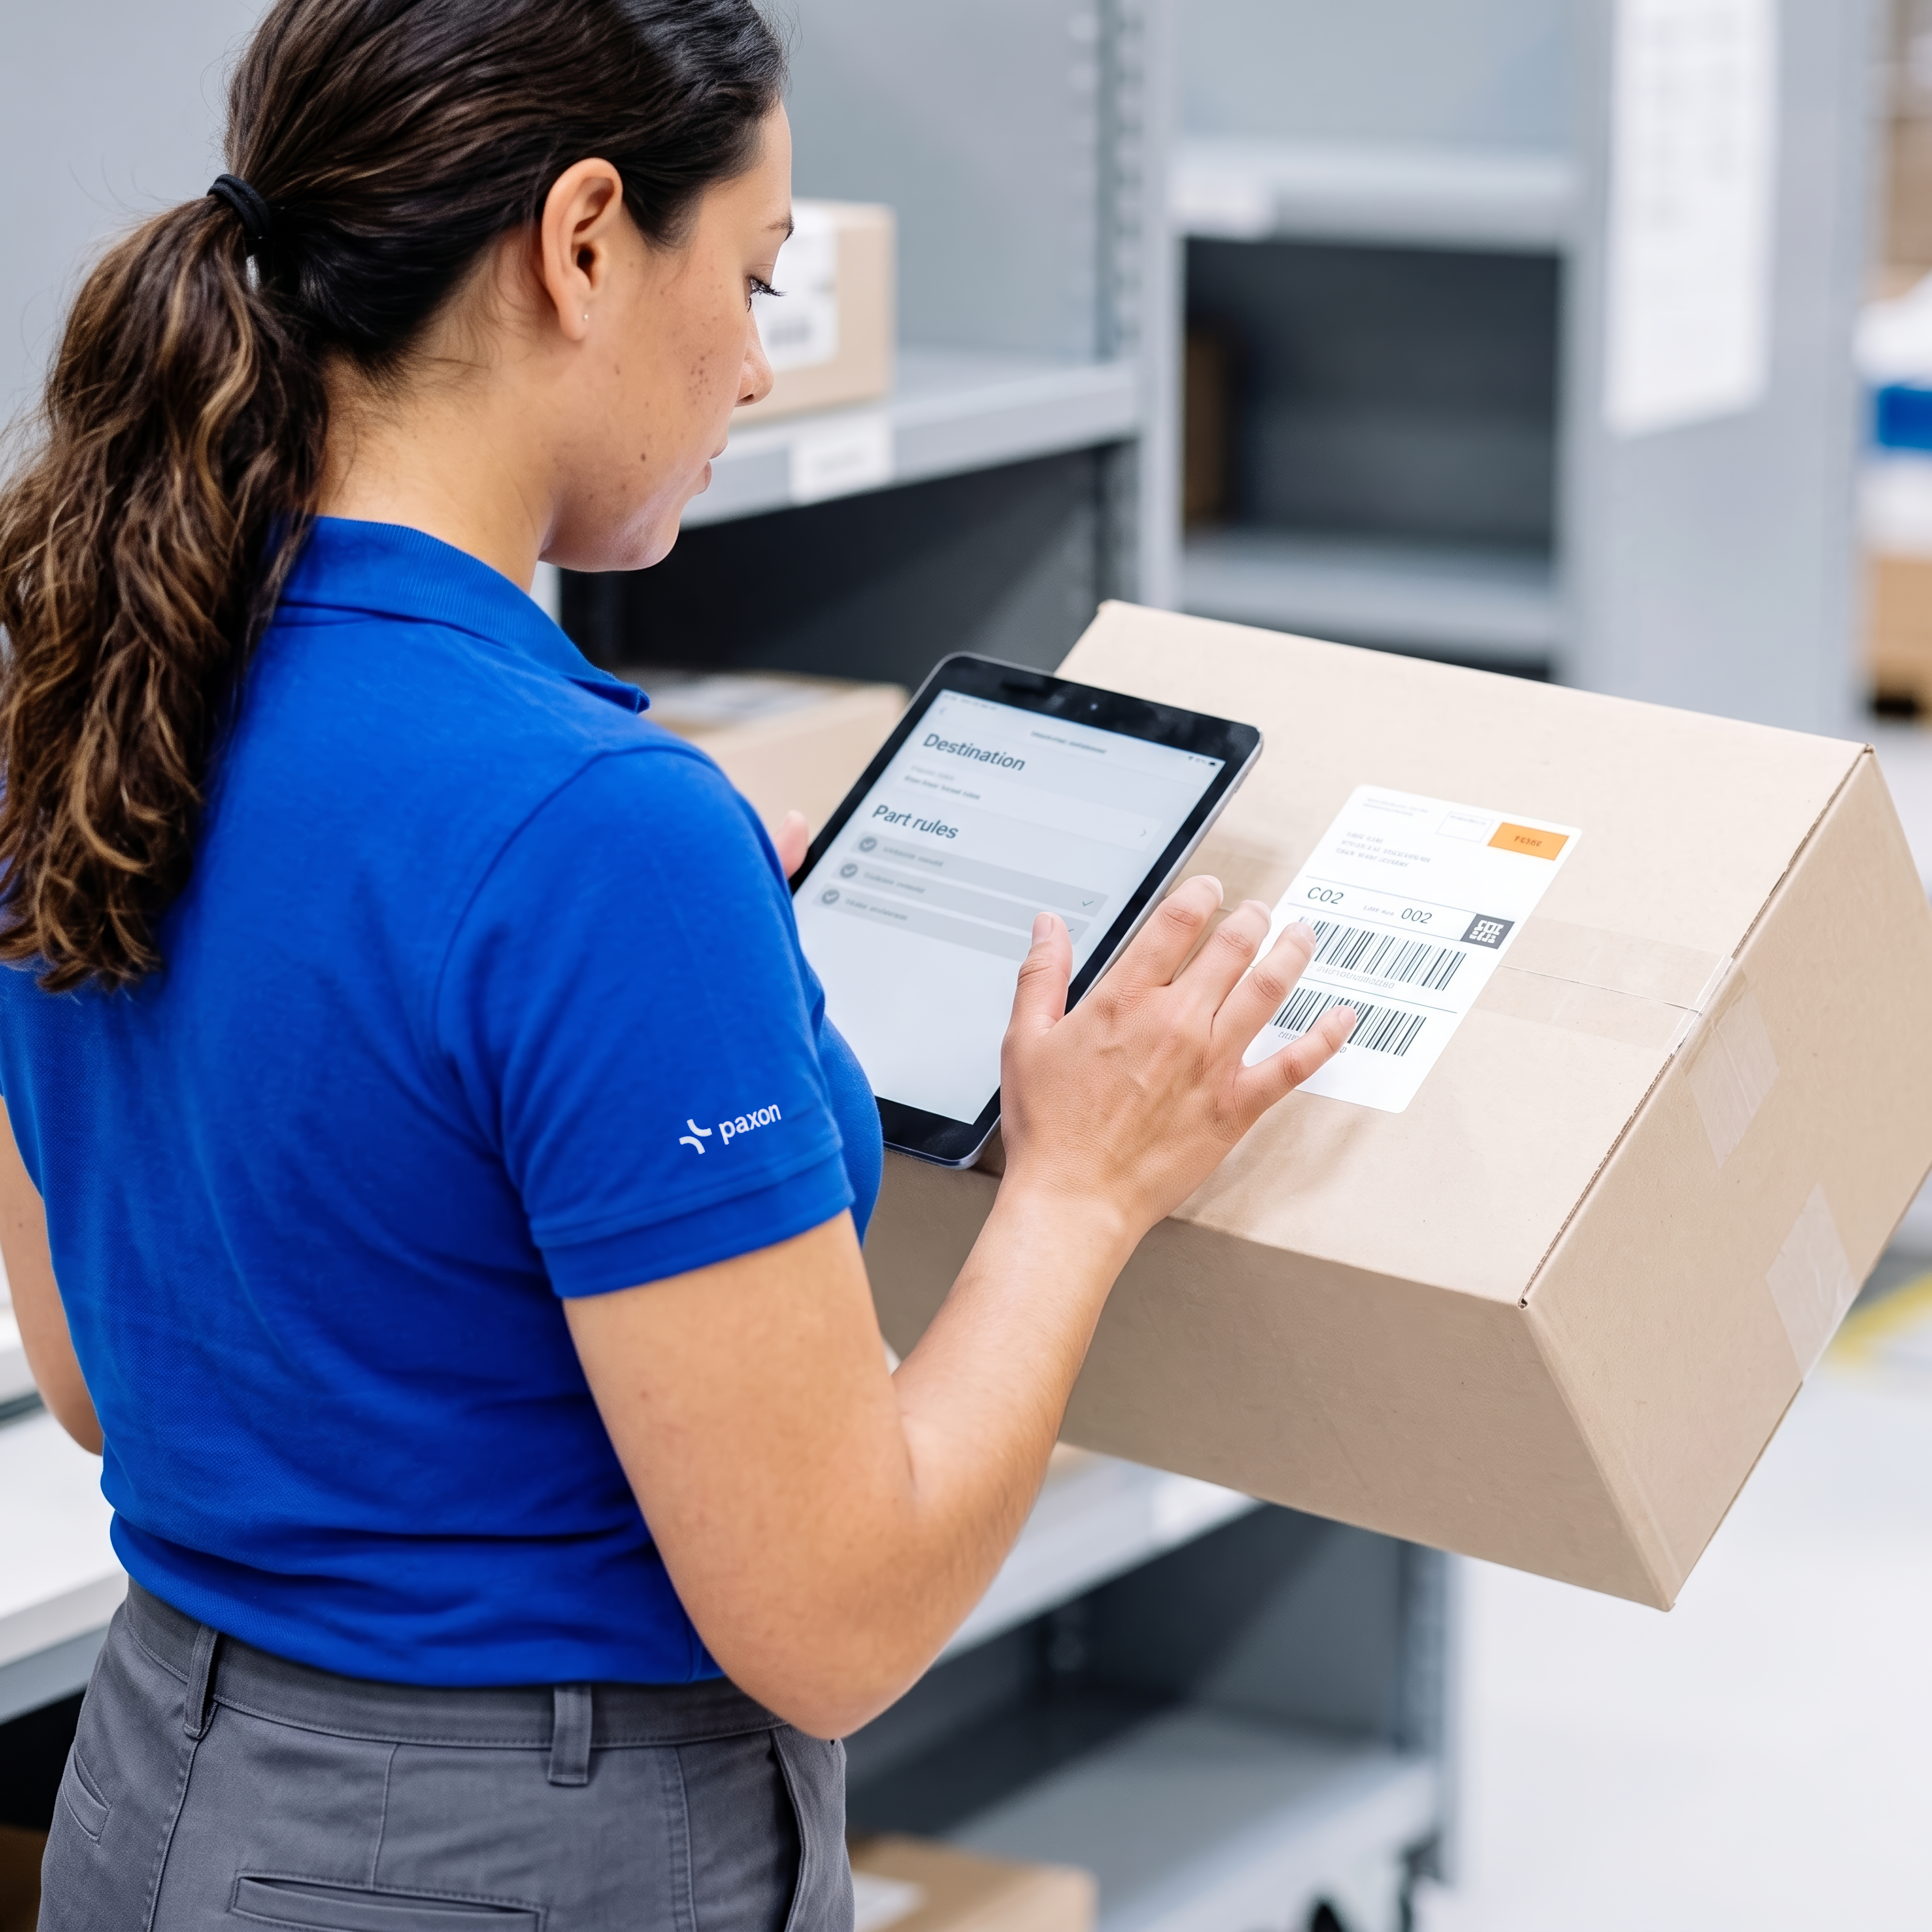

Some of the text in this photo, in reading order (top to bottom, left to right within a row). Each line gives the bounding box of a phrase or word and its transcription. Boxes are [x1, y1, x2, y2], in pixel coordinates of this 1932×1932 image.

[923, 733, 1026, 771] Destination
[872, 804, 959, 839] Part rules
[1401, 908, 1432, 924] 002
[718, 1104, 782, 1145] paxon
